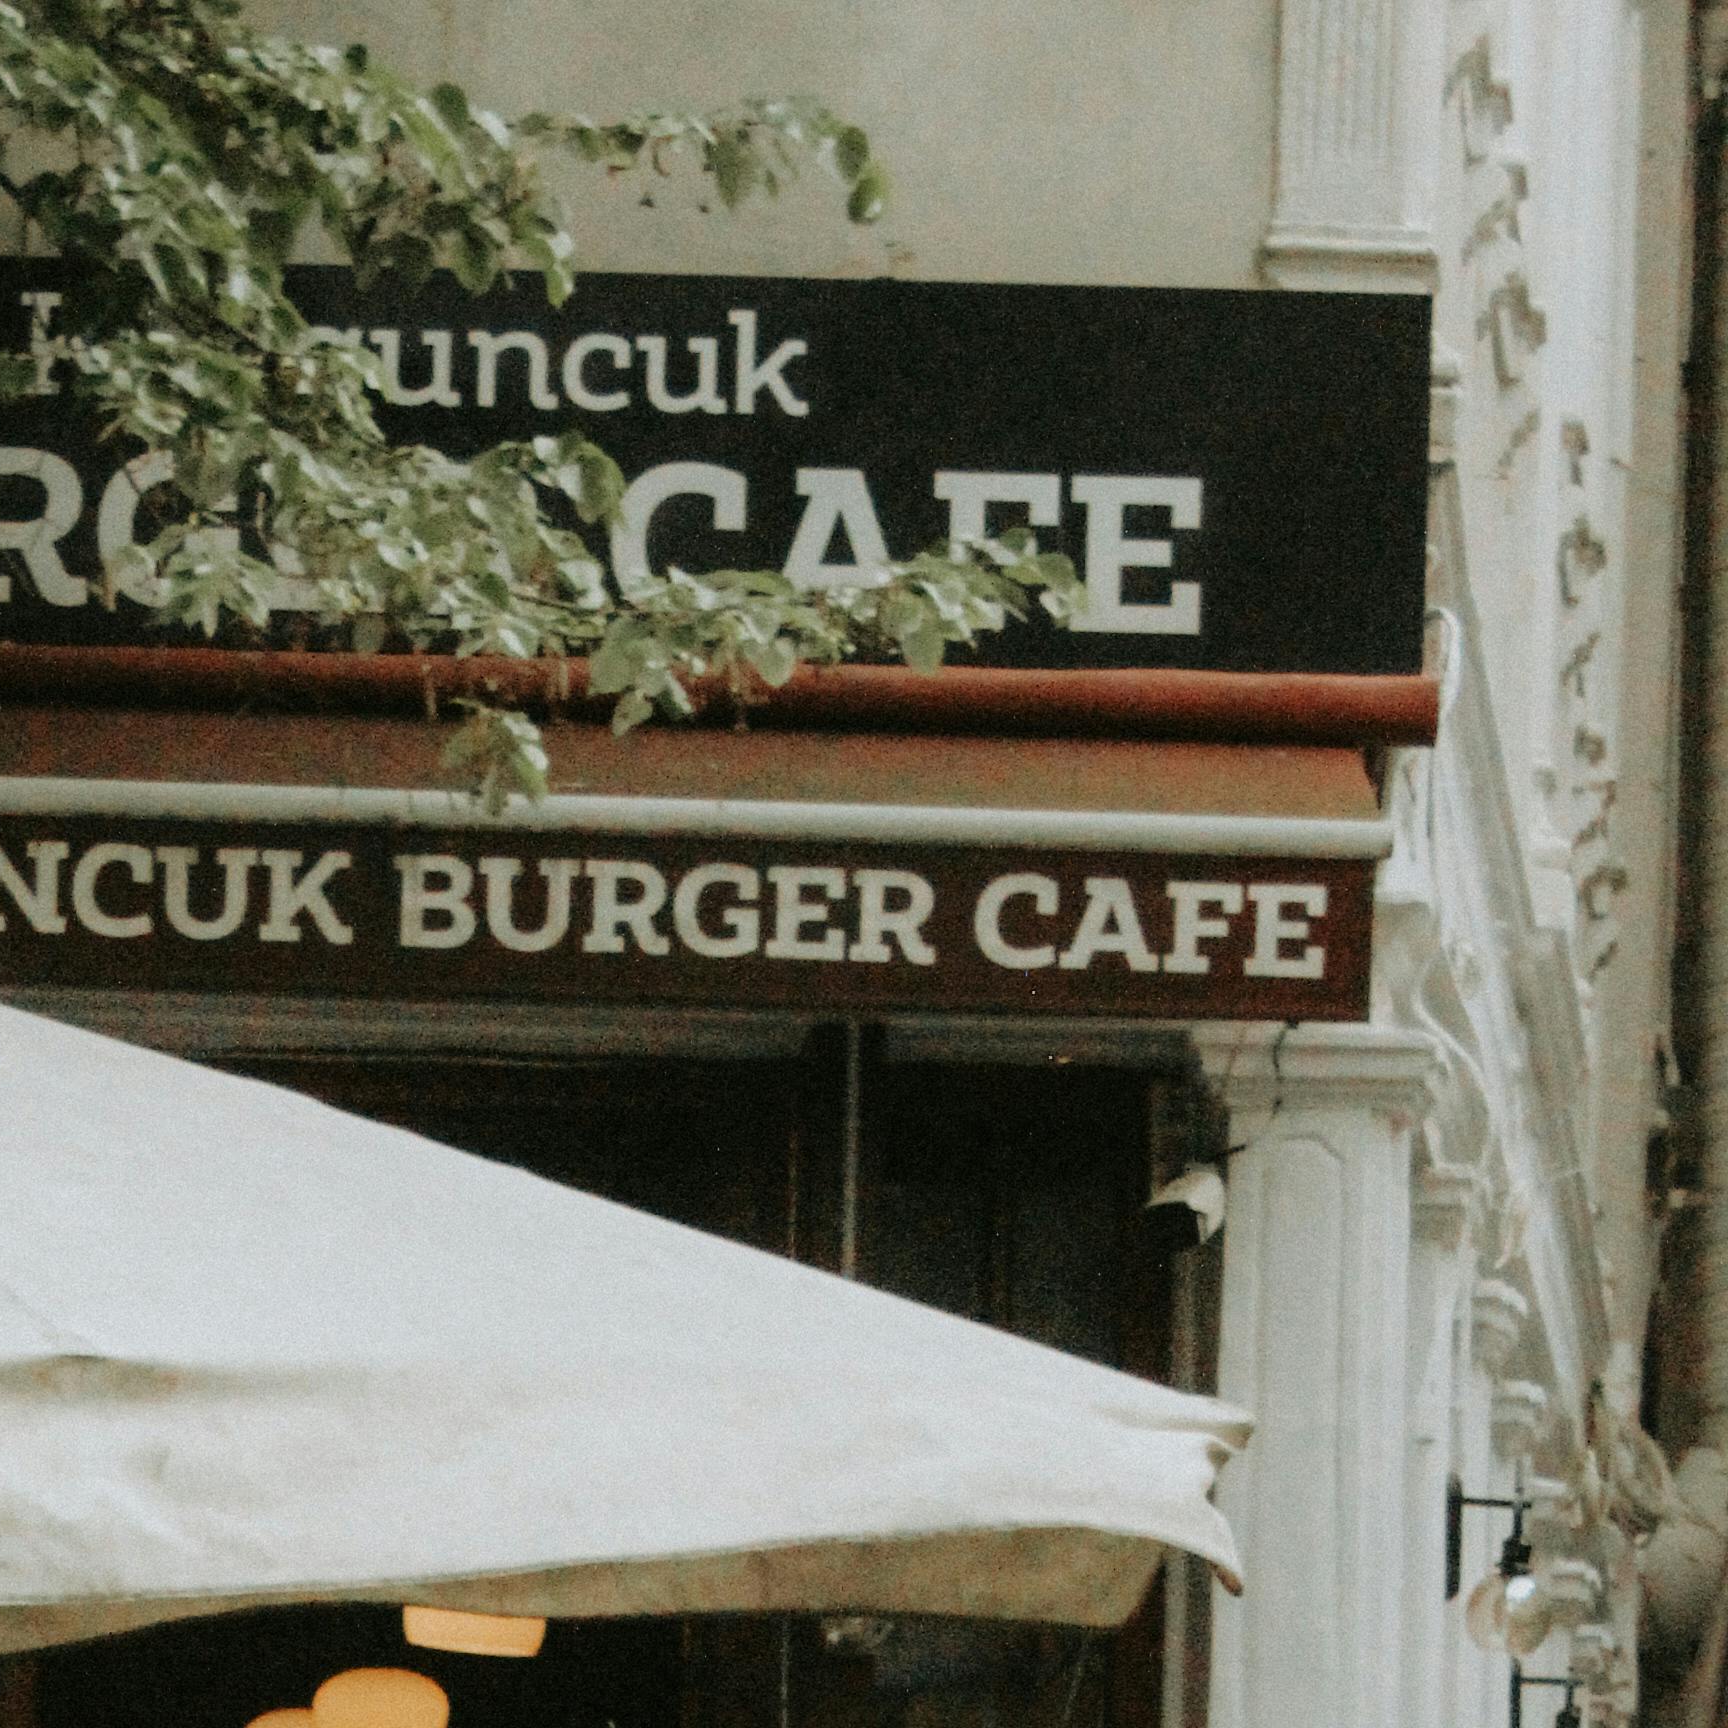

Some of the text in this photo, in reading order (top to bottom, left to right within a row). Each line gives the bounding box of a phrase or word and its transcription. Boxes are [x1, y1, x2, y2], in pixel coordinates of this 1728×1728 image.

[20, 291, 810, 418] uncuk
[610, 461, 1203, 636] CAFE
[393, 853, 937, 966] BURGER
[975, 871, 1328, 980] CAFE
